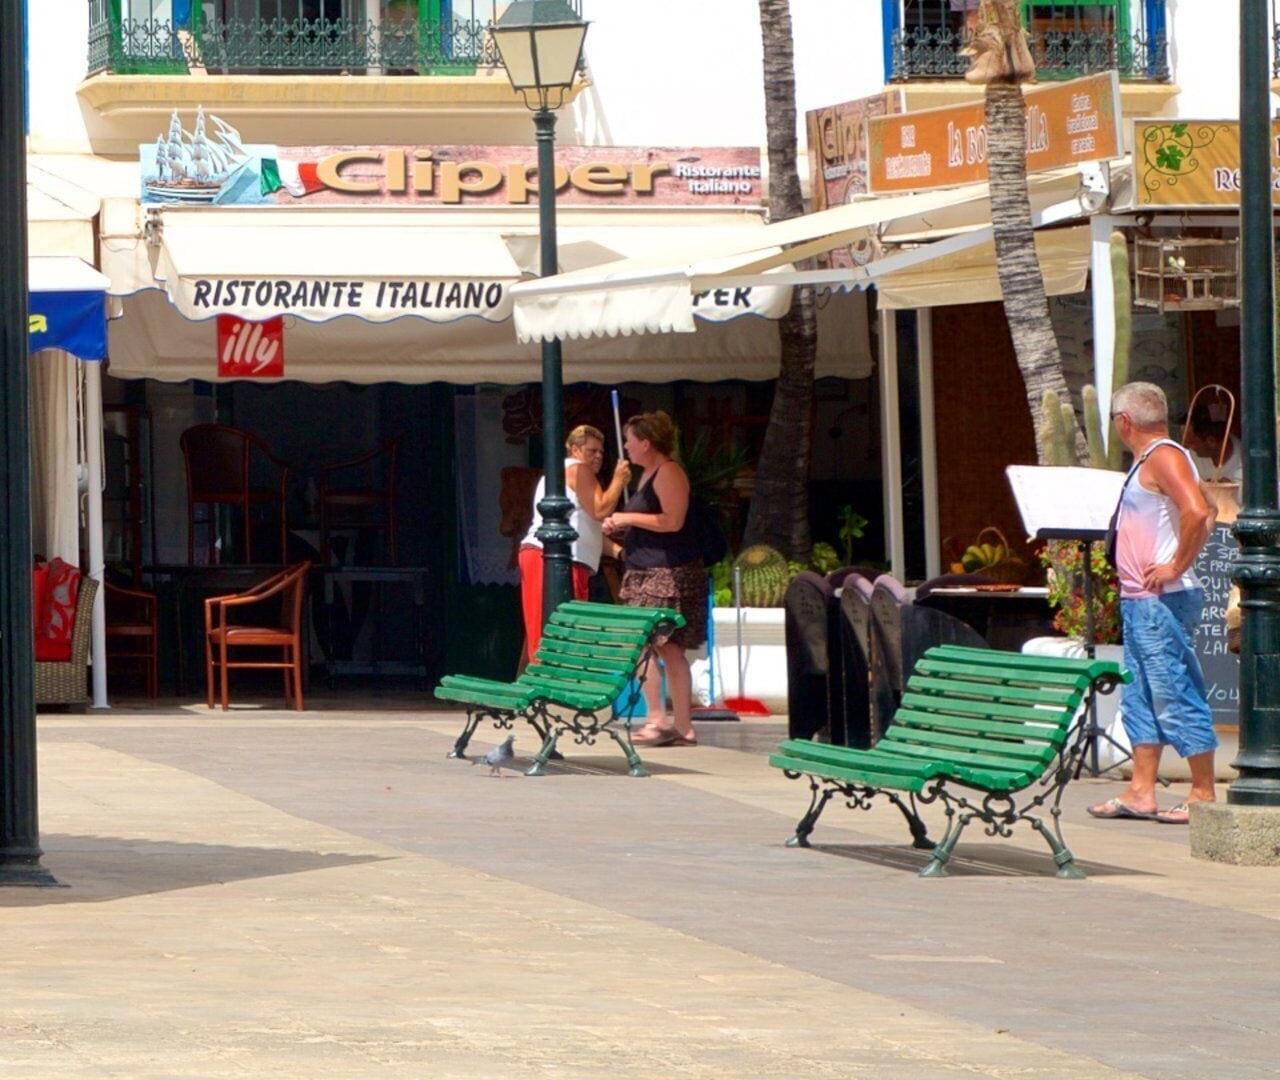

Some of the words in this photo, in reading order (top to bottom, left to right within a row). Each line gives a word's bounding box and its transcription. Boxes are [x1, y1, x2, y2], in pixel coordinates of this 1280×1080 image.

[316, 149, 670, 204] Clipper
[675, 164, 761, 178] Ristorante
[193, 279, 364, 309] RISTORANTE
[375, 281, 504, 309] ITALIANO
[221, 322, 280, 374] illy
